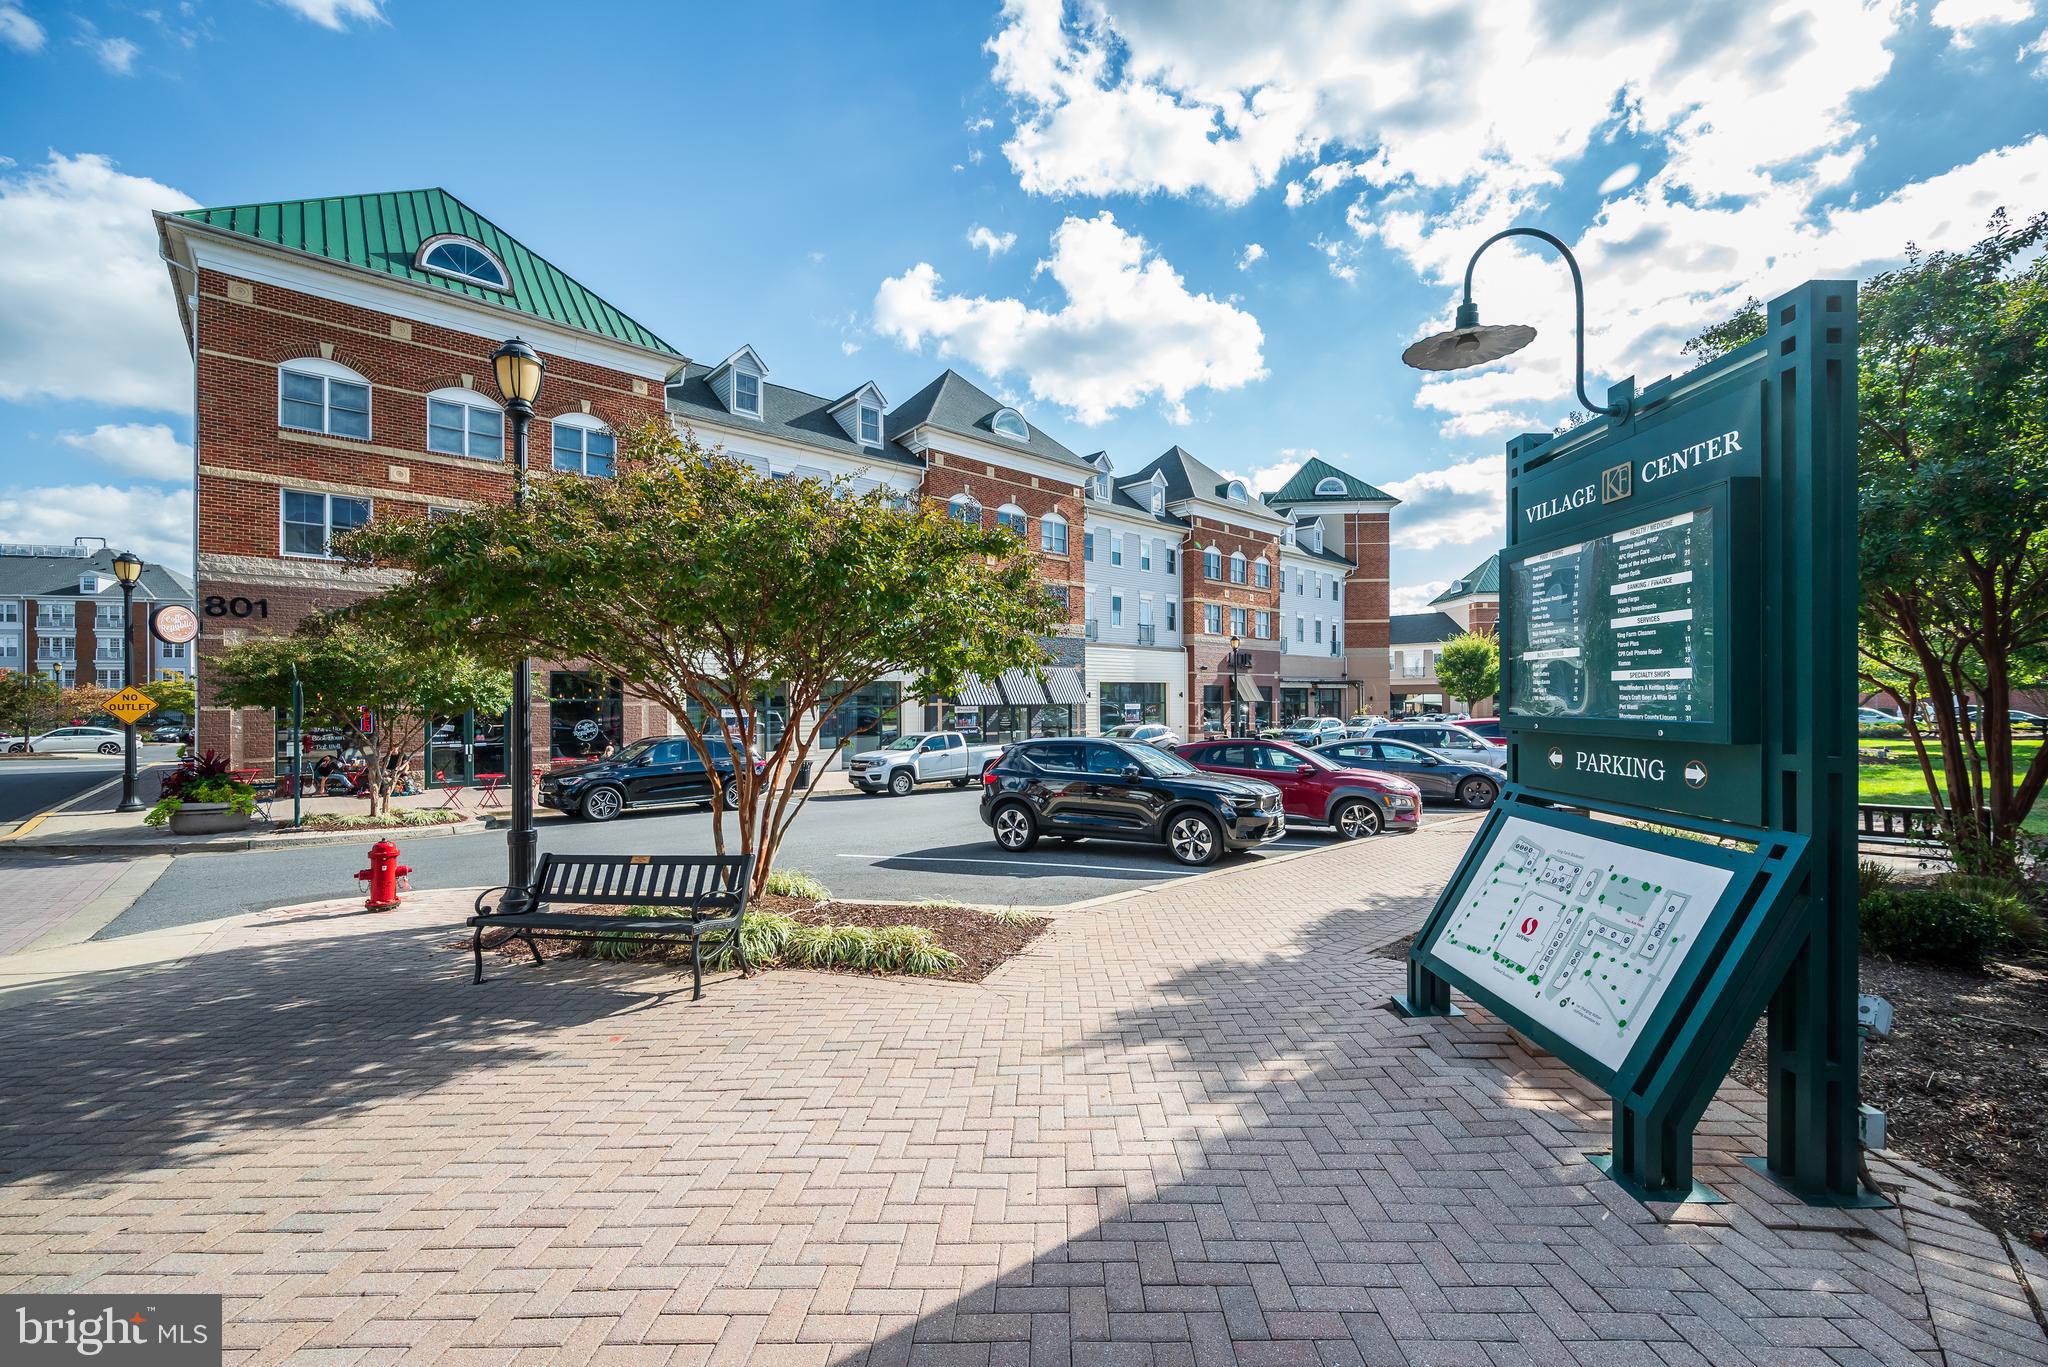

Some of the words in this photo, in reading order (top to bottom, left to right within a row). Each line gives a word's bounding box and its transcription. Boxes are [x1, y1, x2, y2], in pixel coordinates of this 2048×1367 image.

[1526, 484, 1597, 524] VILLAGE
[1641, 430, 1744, 483] CENTER
[1629, 527, 1647, 537] HEALTH
[1650, 519, 1673, 531] MEDICINE
[1627, 551, 1640, 559] Urgent
[1640, 548, 1650, 556] Care
[1618, 562, 1628, 570] State
[1648, 555, 1661, 564] Dental
[1662, 552, 1677, 561] Group
[1627, 581, 1647, 591] BANKING
[1651, 576, 1673, 587] FINANCE
[206, 596, 268, 618] 801
[165, 614, 190, 623] Coffee
[1637, 615, 1660, 624] SERVICES
[162, 619, 194, 632] Republic
[1617, 631, 1626, 639] King
[1626, 630, 1636, 638] Farm
[1648, 647, 1662, 655] Repair
[1629, 670, 1653, 679] SPECIALTY
[1654, 670, 1671, 679] SHOPS
[1649, 683, 1665, 692] Knitting
[109, 703, 151, 711] OUTLET
[1576, 751, 1667, 781] PARKING
